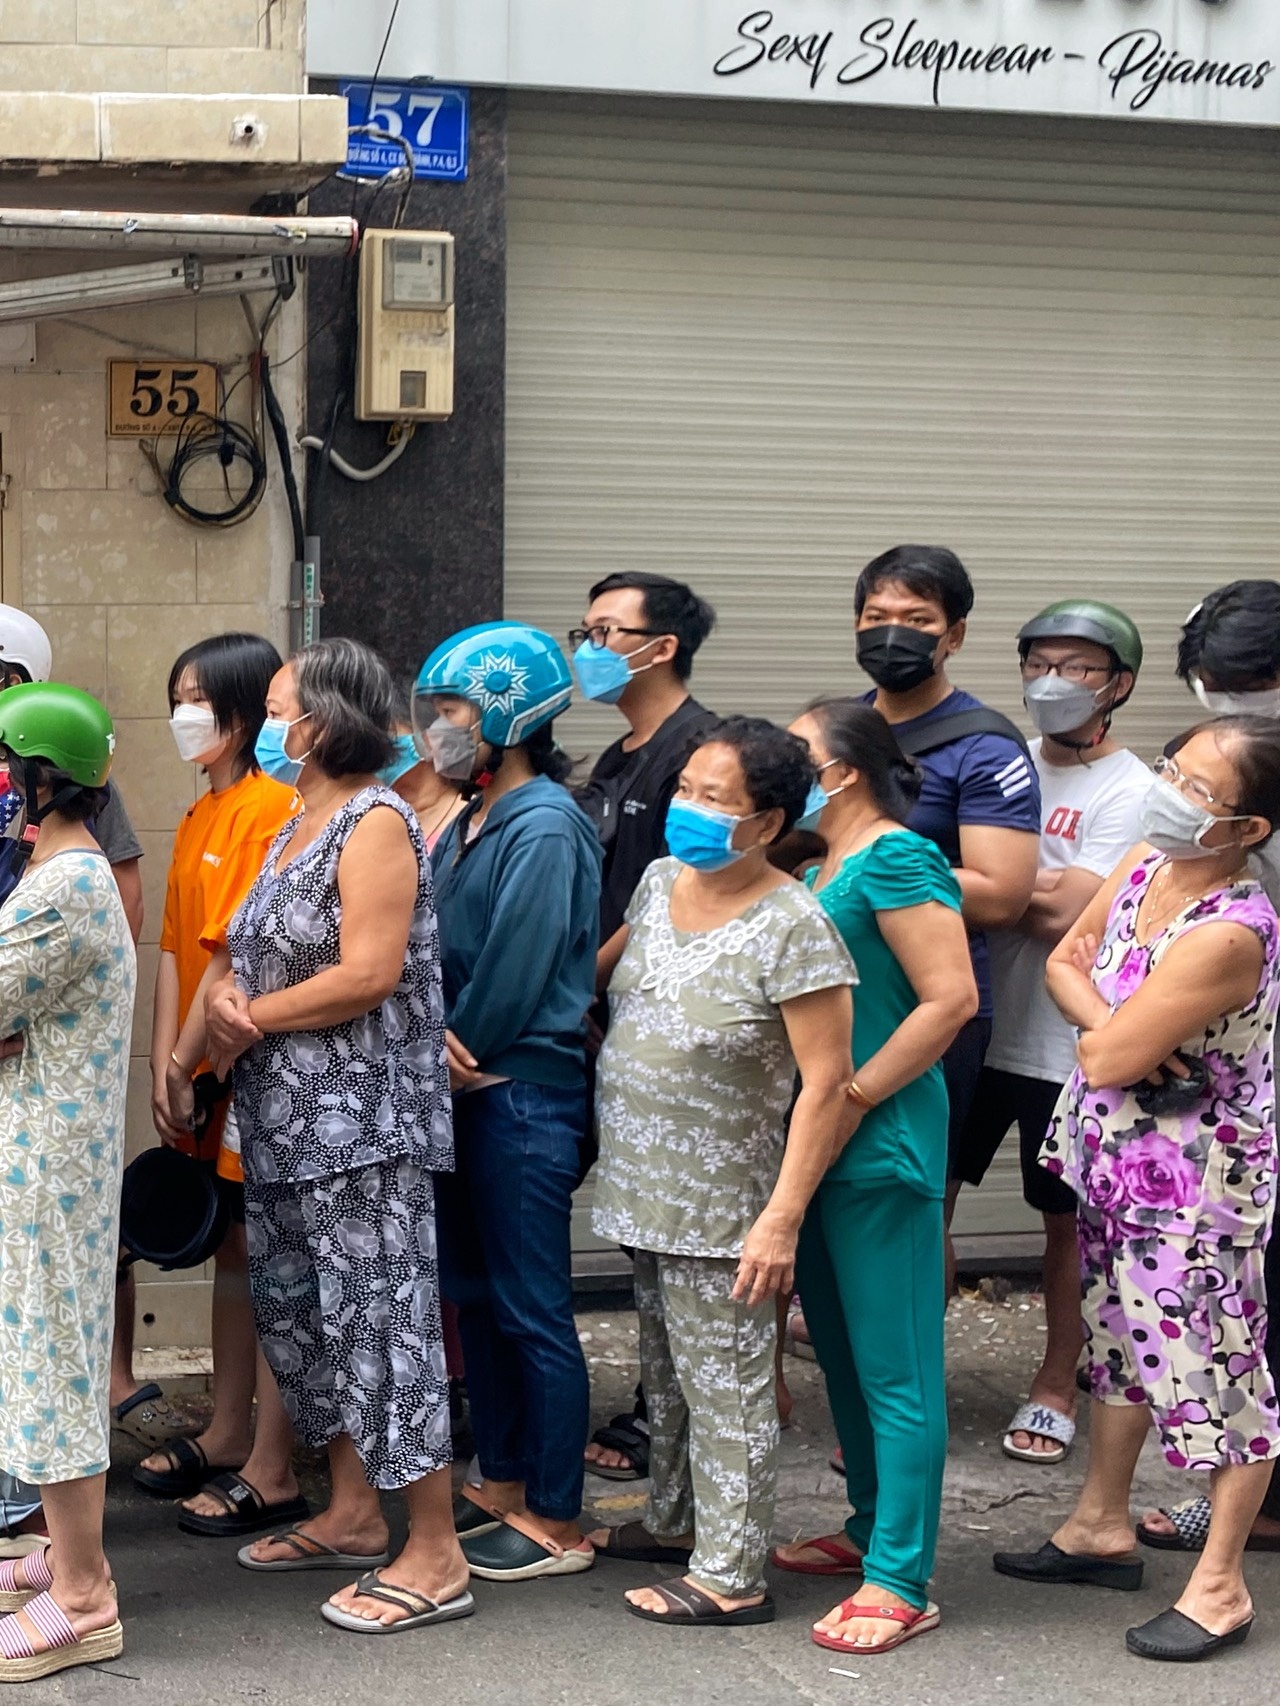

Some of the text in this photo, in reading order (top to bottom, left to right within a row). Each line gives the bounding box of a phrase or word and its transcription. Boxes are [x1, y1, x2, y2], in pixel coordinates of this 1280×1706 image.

[713, 10, 834, 89] Sexy
[837, 18, 1056, 106] Sleepwear
[1098, 29, 1276, 110] Pijamas
[367, 91, 444, 147] 57
[130, 369, 200, 418] 55
